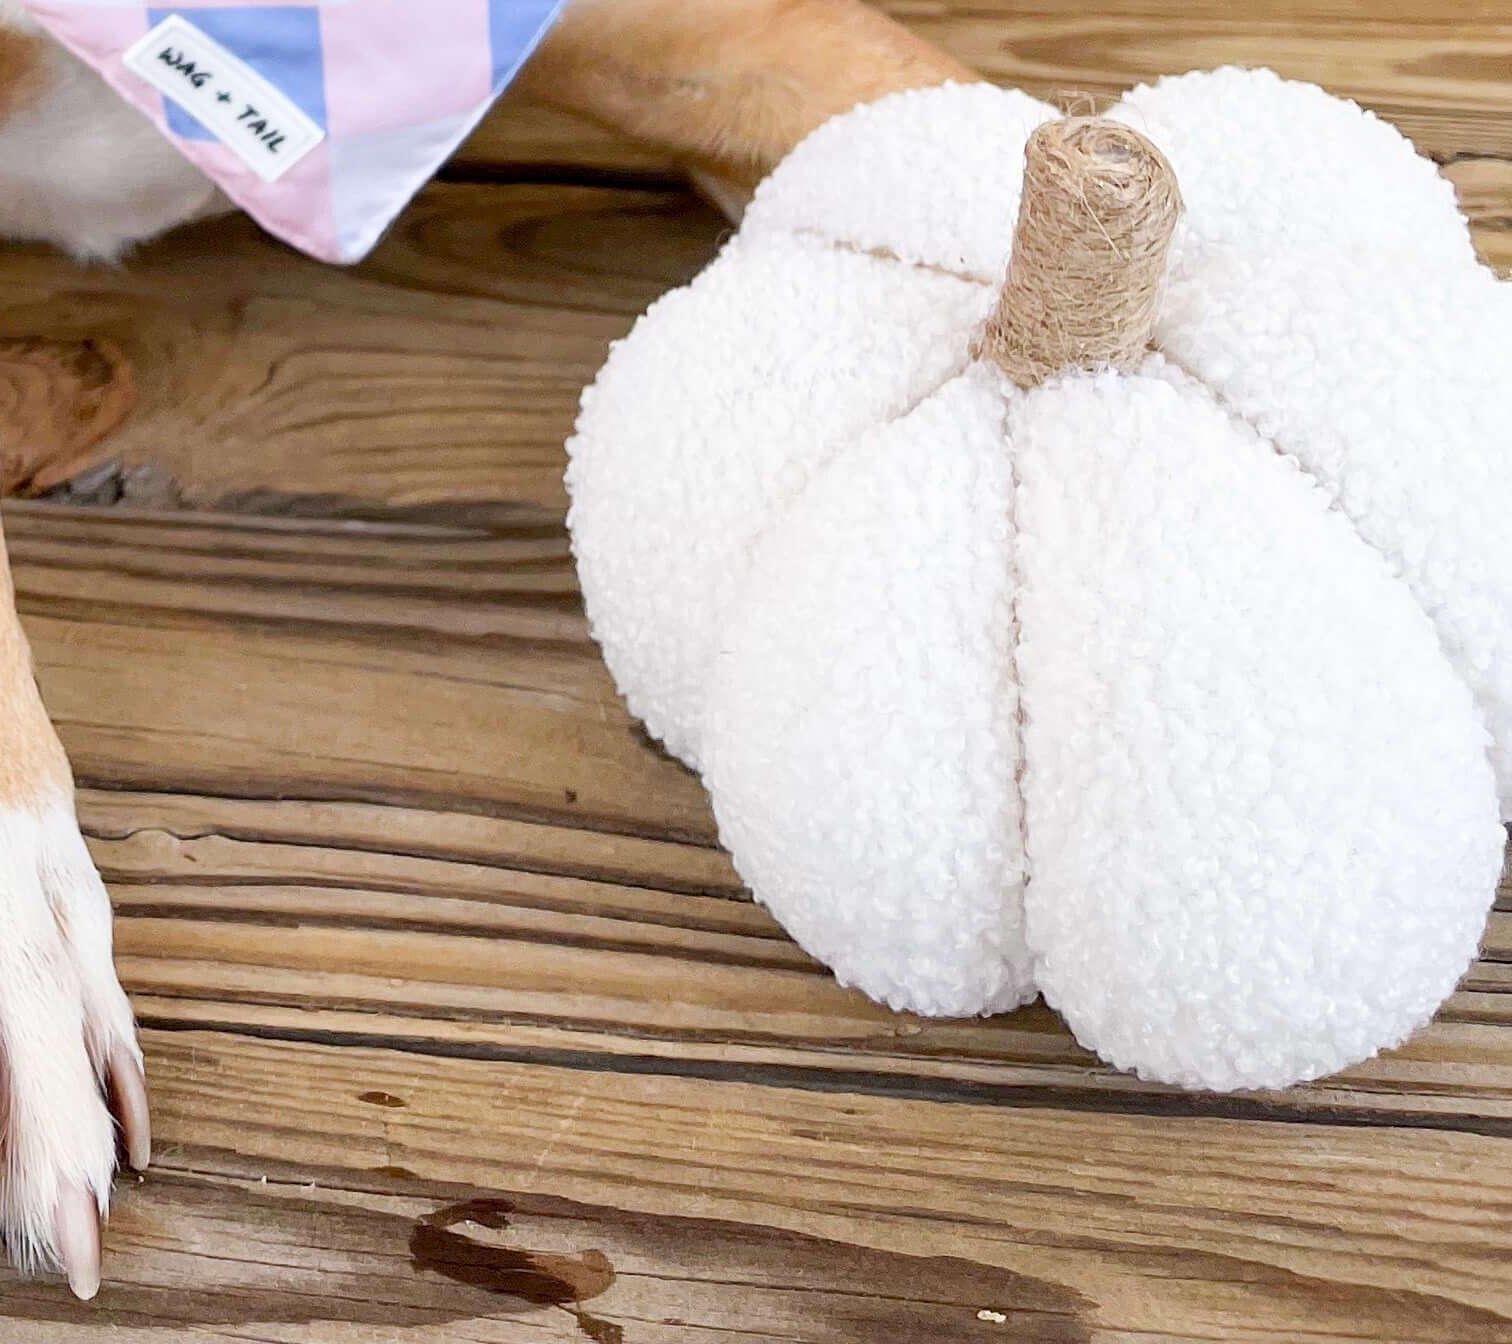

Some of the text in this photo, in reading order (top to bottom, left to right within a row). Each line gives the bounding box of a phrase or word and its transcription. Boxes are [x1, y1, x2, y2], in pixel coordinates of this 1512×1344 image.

[158, 47, 286, 153] WAG + TAIL
